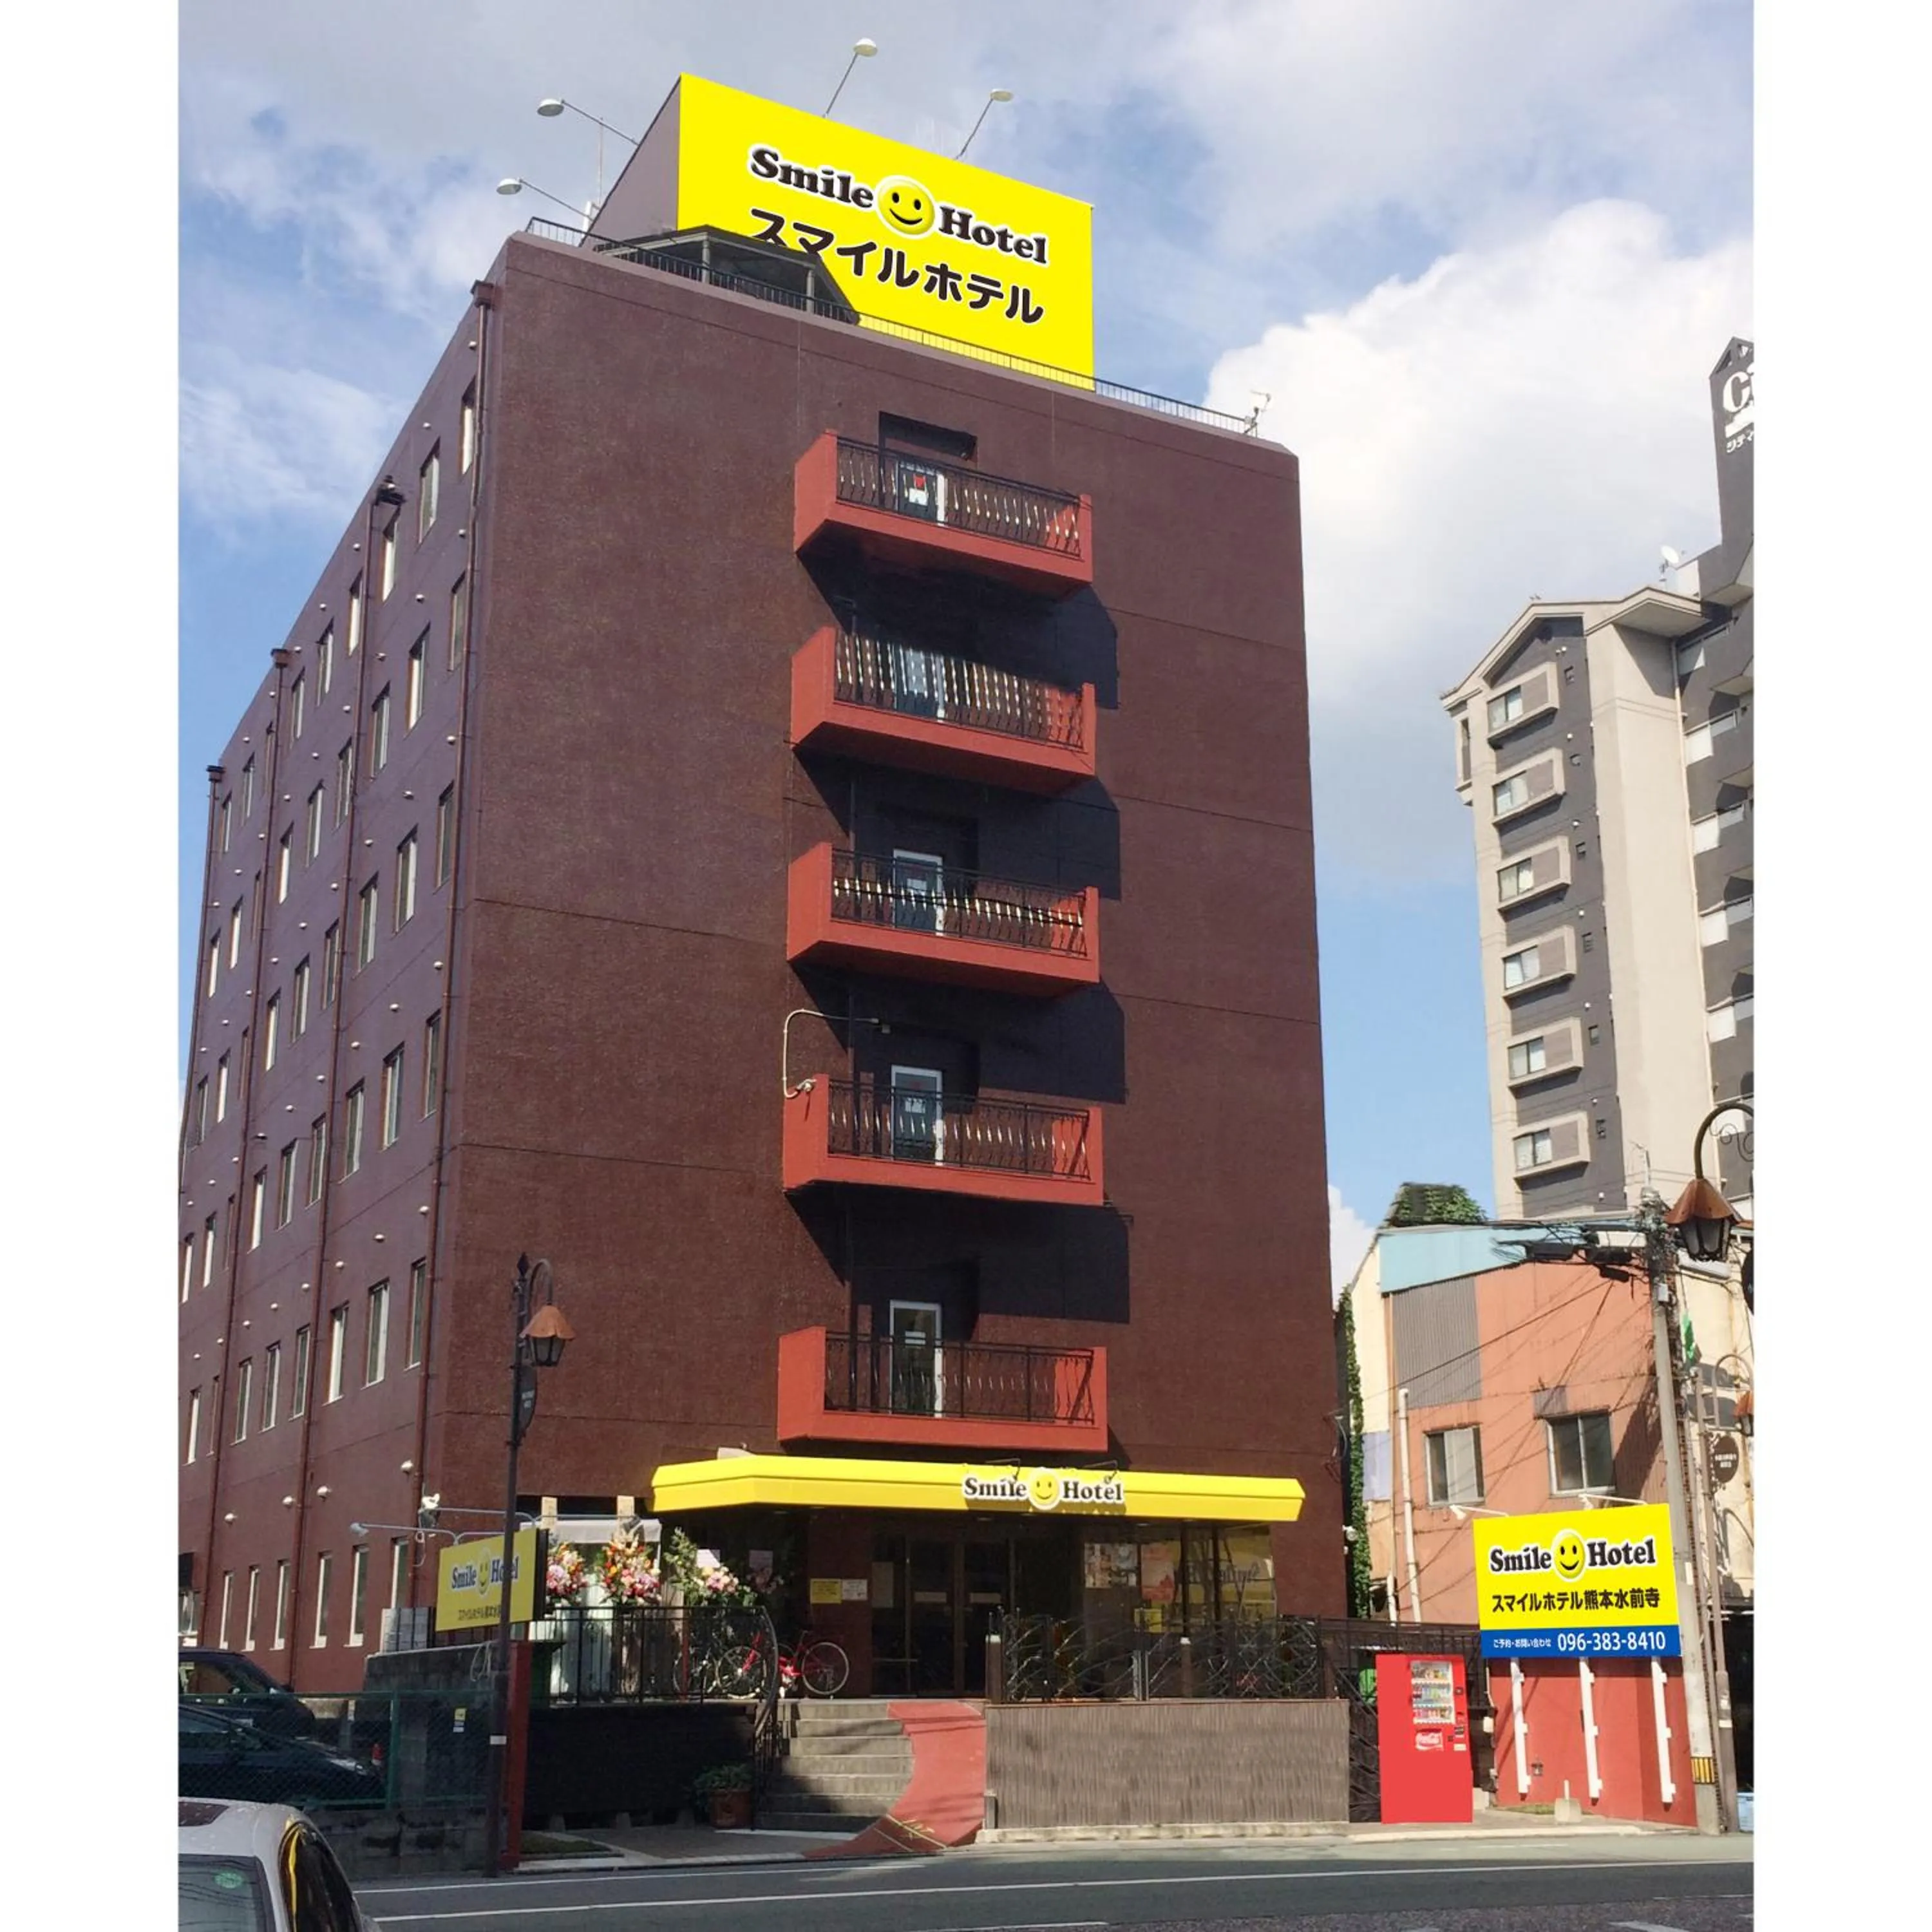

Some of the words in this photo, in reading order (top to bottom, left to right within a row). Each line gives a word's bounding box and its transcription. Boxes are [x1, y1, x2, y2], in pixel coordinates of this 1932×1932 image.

[751, 149, 874, 208] Smile
[938, 206, 1046, 264] Hotel
[751, 208, 1044, 323] スマイルホテル
[965, 1477, 1027, 1498] Smile
[1063, 1481, 1122, 1501] Hotel
[1490, 1546, 1551, 1572] Smile
[1587, 1539, 1656, 1567] Hotel
[451, 1565, 477, 1589] Smile
[1492, 1587, 1660, 1613] スマイルホテル熊本水前寺
[1557, 1631, 1667, 1651] 096-383-8410
